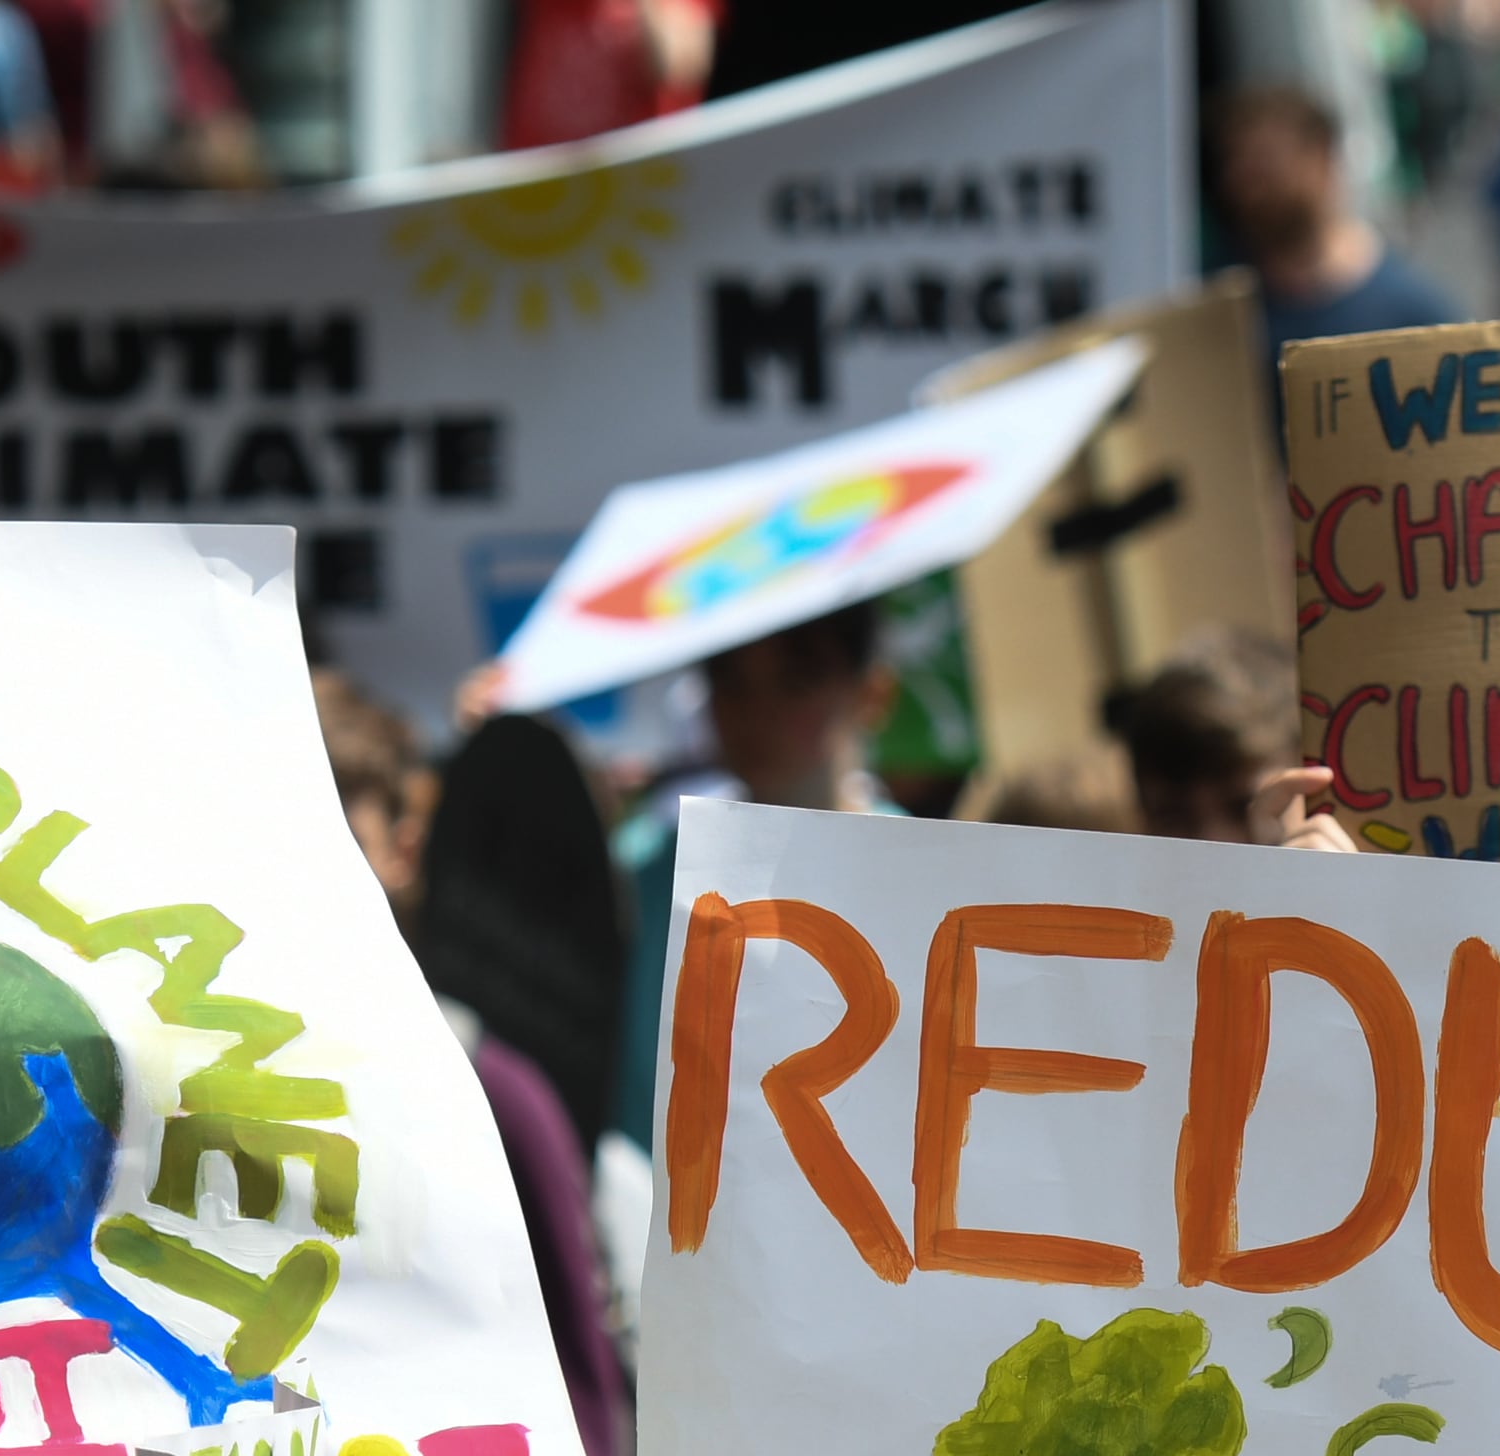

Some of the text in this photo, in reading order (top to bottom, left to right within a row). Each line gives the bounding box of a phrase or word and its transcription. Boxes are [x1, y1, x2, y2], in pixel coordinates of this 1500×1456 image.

[770, 160, 1100, 237] CLIMATE
[712, 270, 1092, 410] MARCH
[1311, 376, 1350, 438] IF
